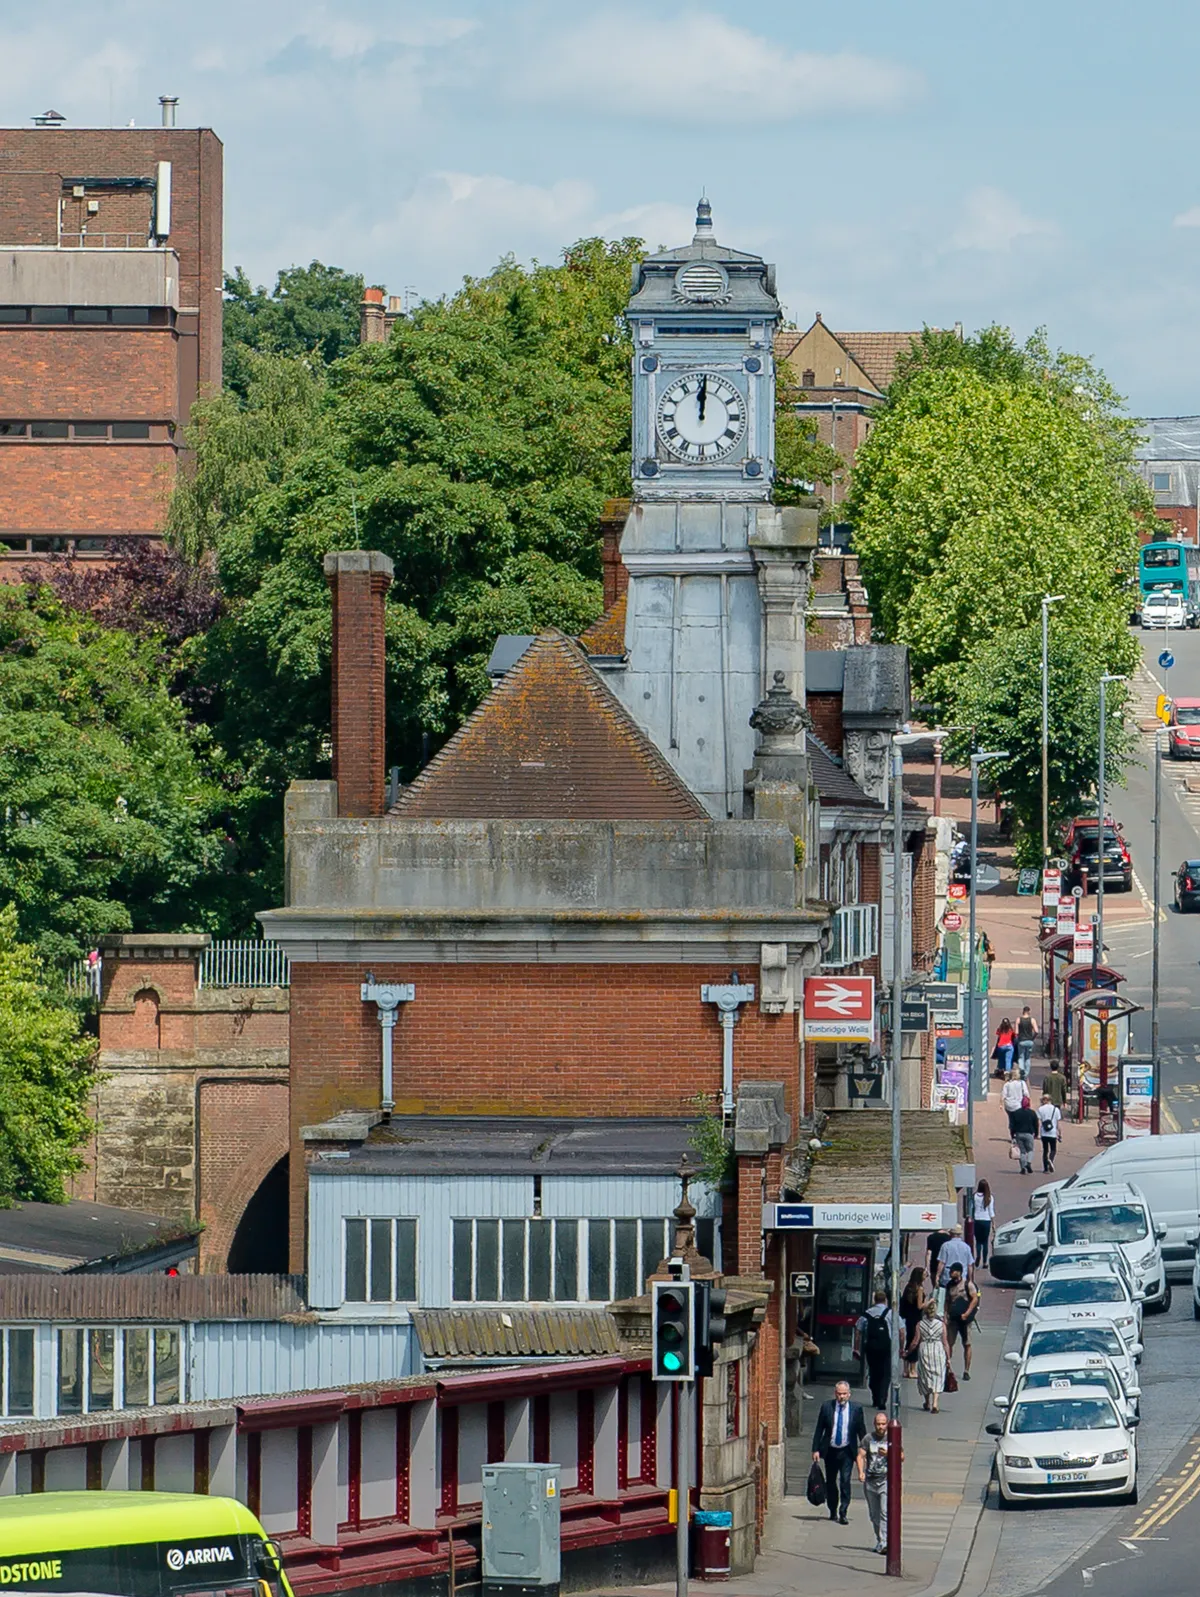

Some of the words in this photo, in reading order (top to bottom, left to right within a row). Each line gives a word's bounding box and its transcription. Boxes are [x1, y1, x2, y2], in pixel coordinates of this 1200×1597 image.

[808, 1025, 847, 1035] Tunbridge
[848, 1025, 869, 1034] Wells
[821, 1212, 869, 1223] Tunbridge
[870, 1212, 893, 1222] Well
[185, 1546, 234, 1565] ARRIVA
[0, 1560, 62, 1583] DSTONE
